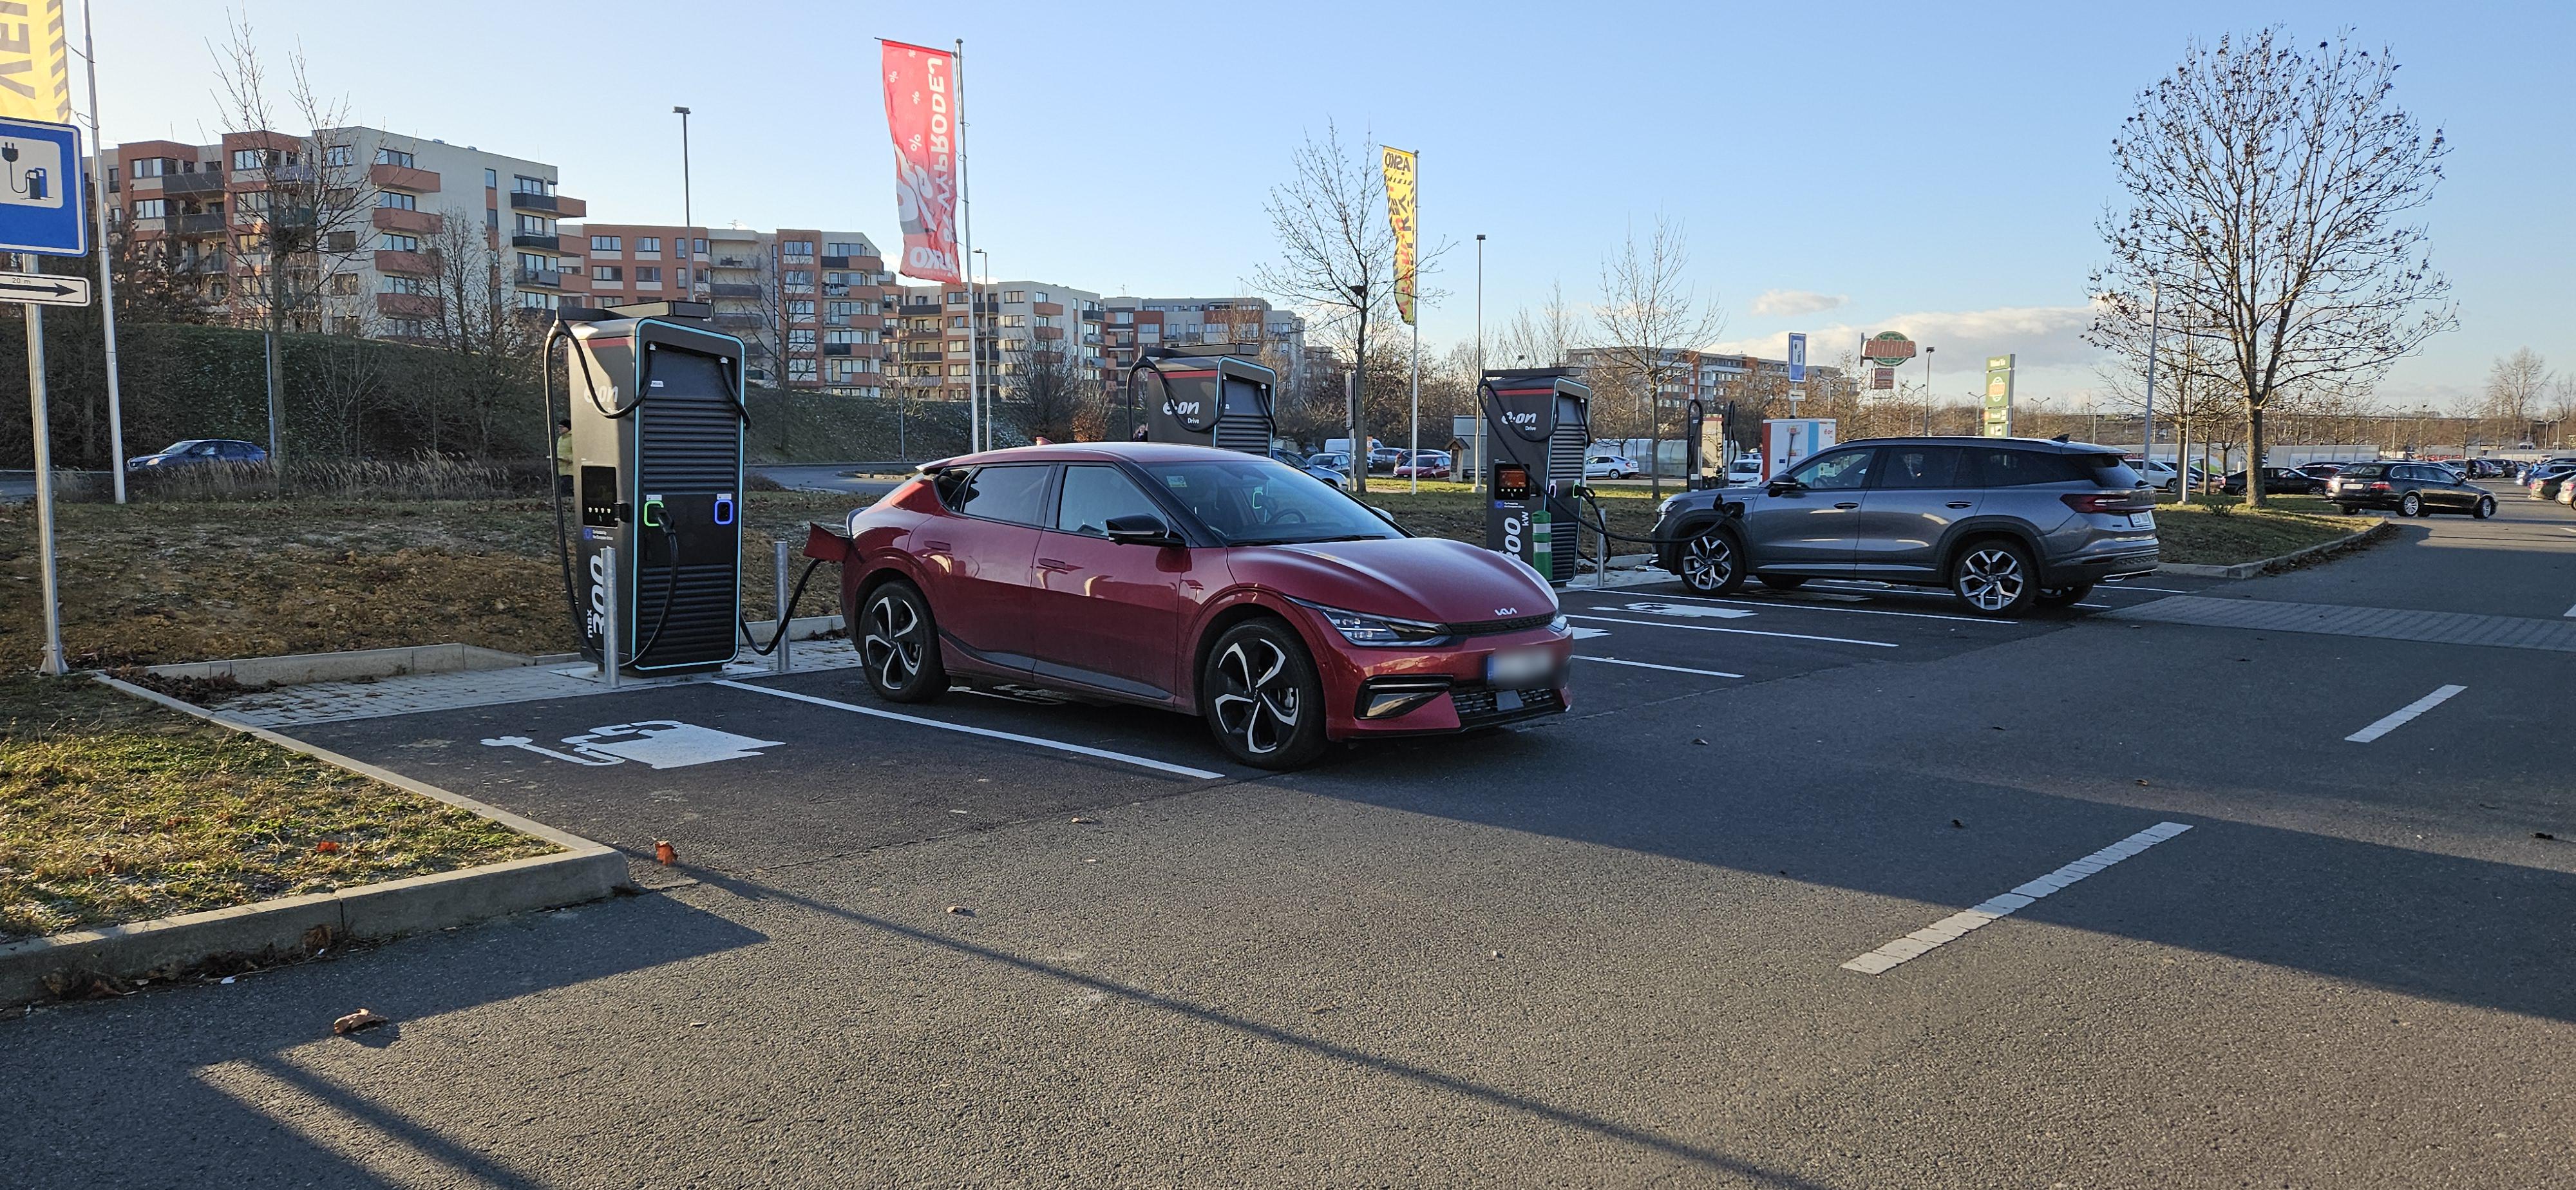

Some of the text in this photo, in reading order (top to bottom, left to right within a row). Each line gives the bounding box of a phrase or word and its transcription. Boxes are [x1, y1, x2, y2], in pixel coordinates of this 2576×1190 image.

[1864, 337, 1916, 357] Globus
[1522, 511, 1529, 526] kW
[591, 554, 605, 635] 300
